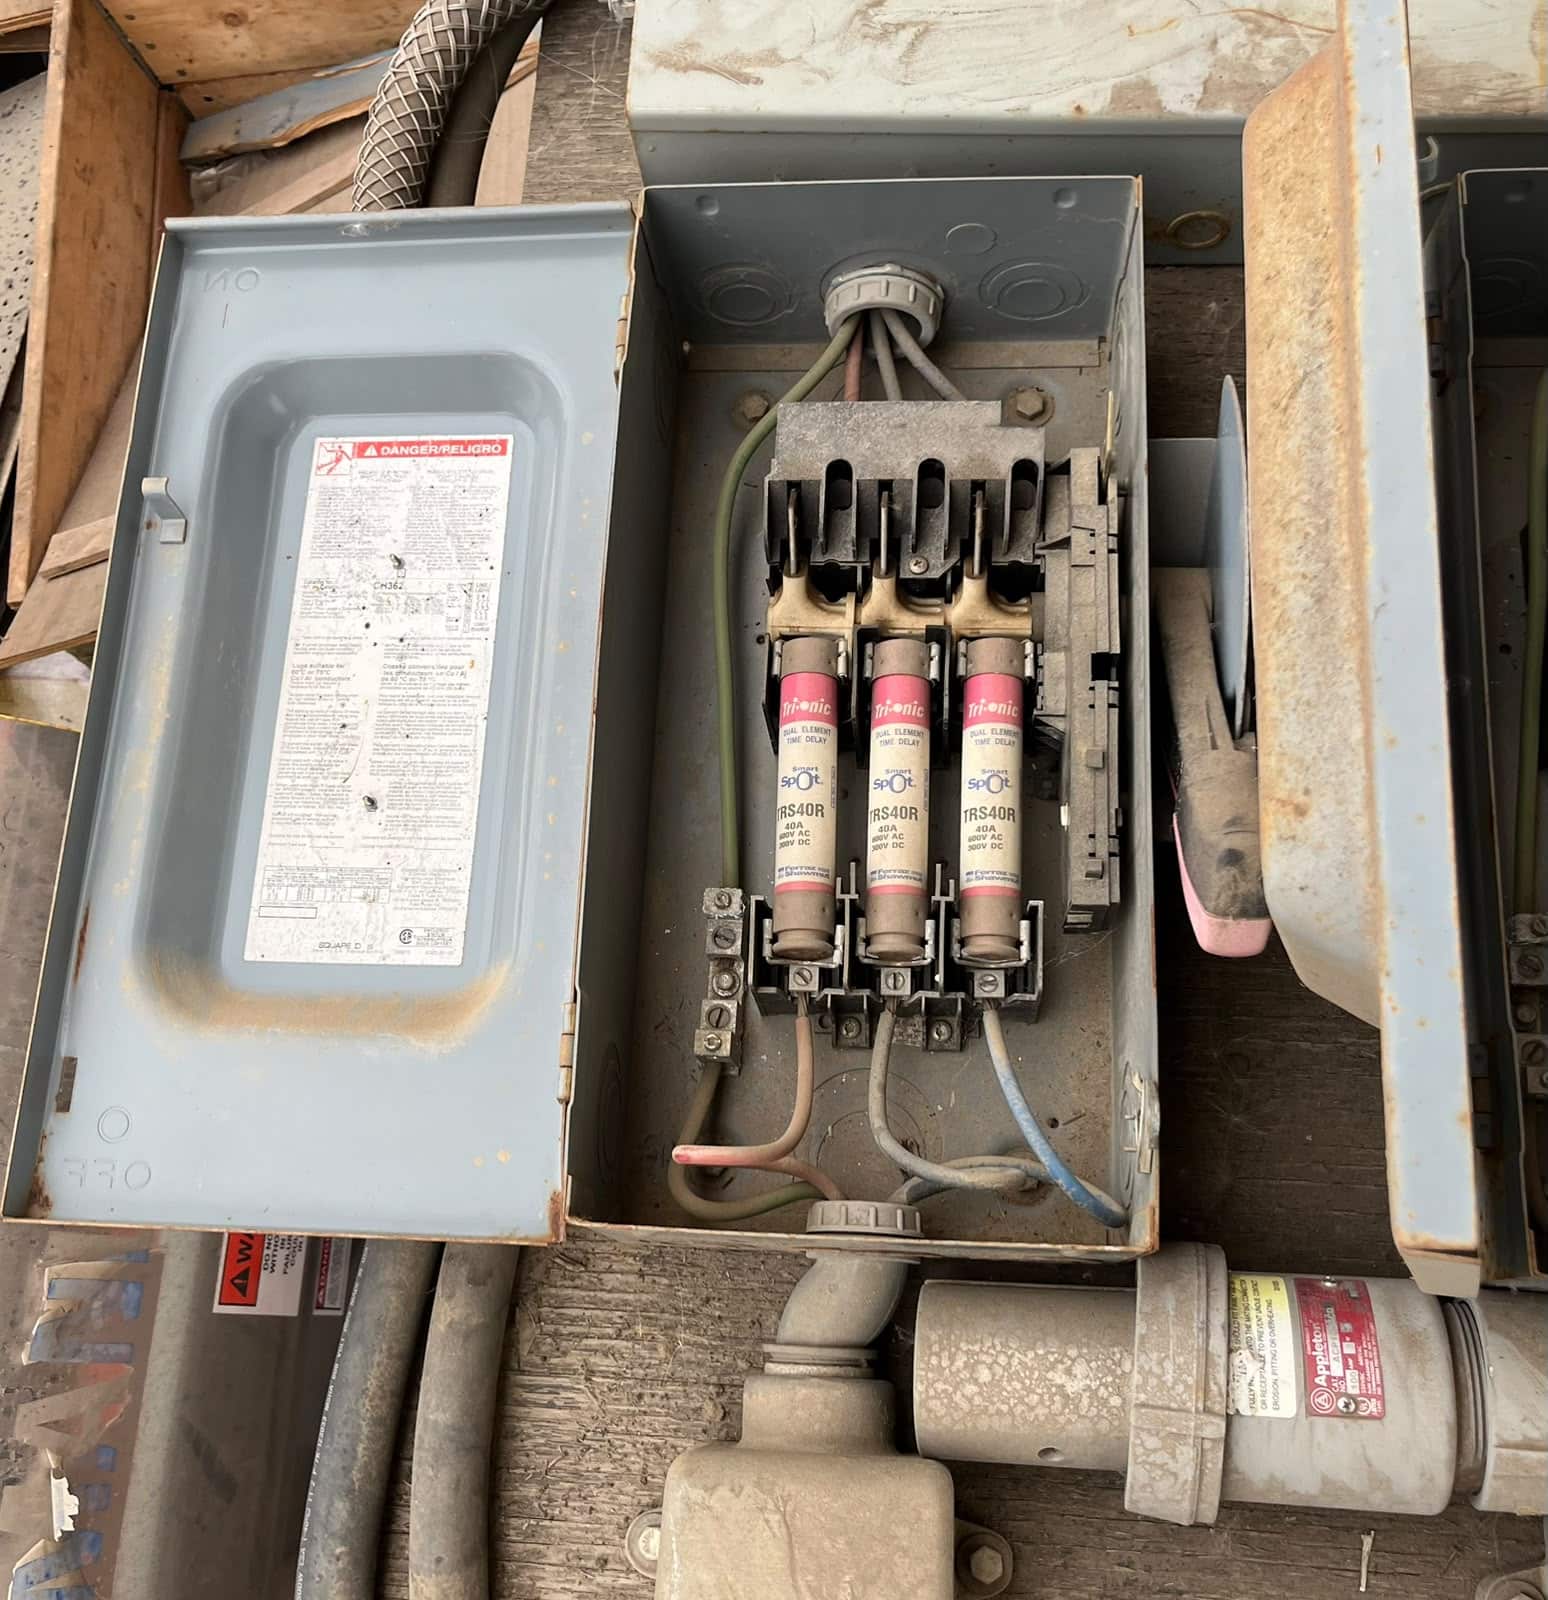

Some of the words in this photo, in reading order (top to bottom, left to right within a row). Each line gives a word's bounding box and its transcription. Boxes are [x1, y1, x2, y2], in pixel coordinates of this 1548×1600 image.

[802, 725, 831, 737] ELEMENT
[895, 728, 925, 738] ELEMENT
[991, 727, 1020, 738] ELEMENT
[787, 735, 801, 744] TIME
[805, 735, 827, 744] DELAY
[898, 737, 920, 747] DELAY
[994, 737, 1016, 747] DELAY
[778, 802, 825, 822] TRS40R
[870, 805, 918, 825] TRS40R
[963, 805, 1016, 824] TRS40R
[784, 821, 804, 830] 40A
[878, 824, 897, 833] 40A
[975, 824, 996, 833] 40A
[779, 831, 796, 841] 600V
[871, 834, 889, 843] 600V
[967, 834, 988, 843] 600V
[990, 833, 1003, 841] AC
[798, 838, 811, 846] DC
[990, 842, 1003, 850] DC
[263, 1254, 270, 1271] DO
[1242, 1324, 1252, 1335] THE
[1254, 1315, 1265, 1342] PREVENT
[1257, 1342, 1265, 1353] TO
[1268, 1338, 1277, 1348] OR
[1311, 1323, 1330, 1387] Appleton
[1270, 1349, 1279, 1377] PITTING
[1247, 1388, 1256, 1409] FULLY
[1260, 1399, 1268, 1410] OR
